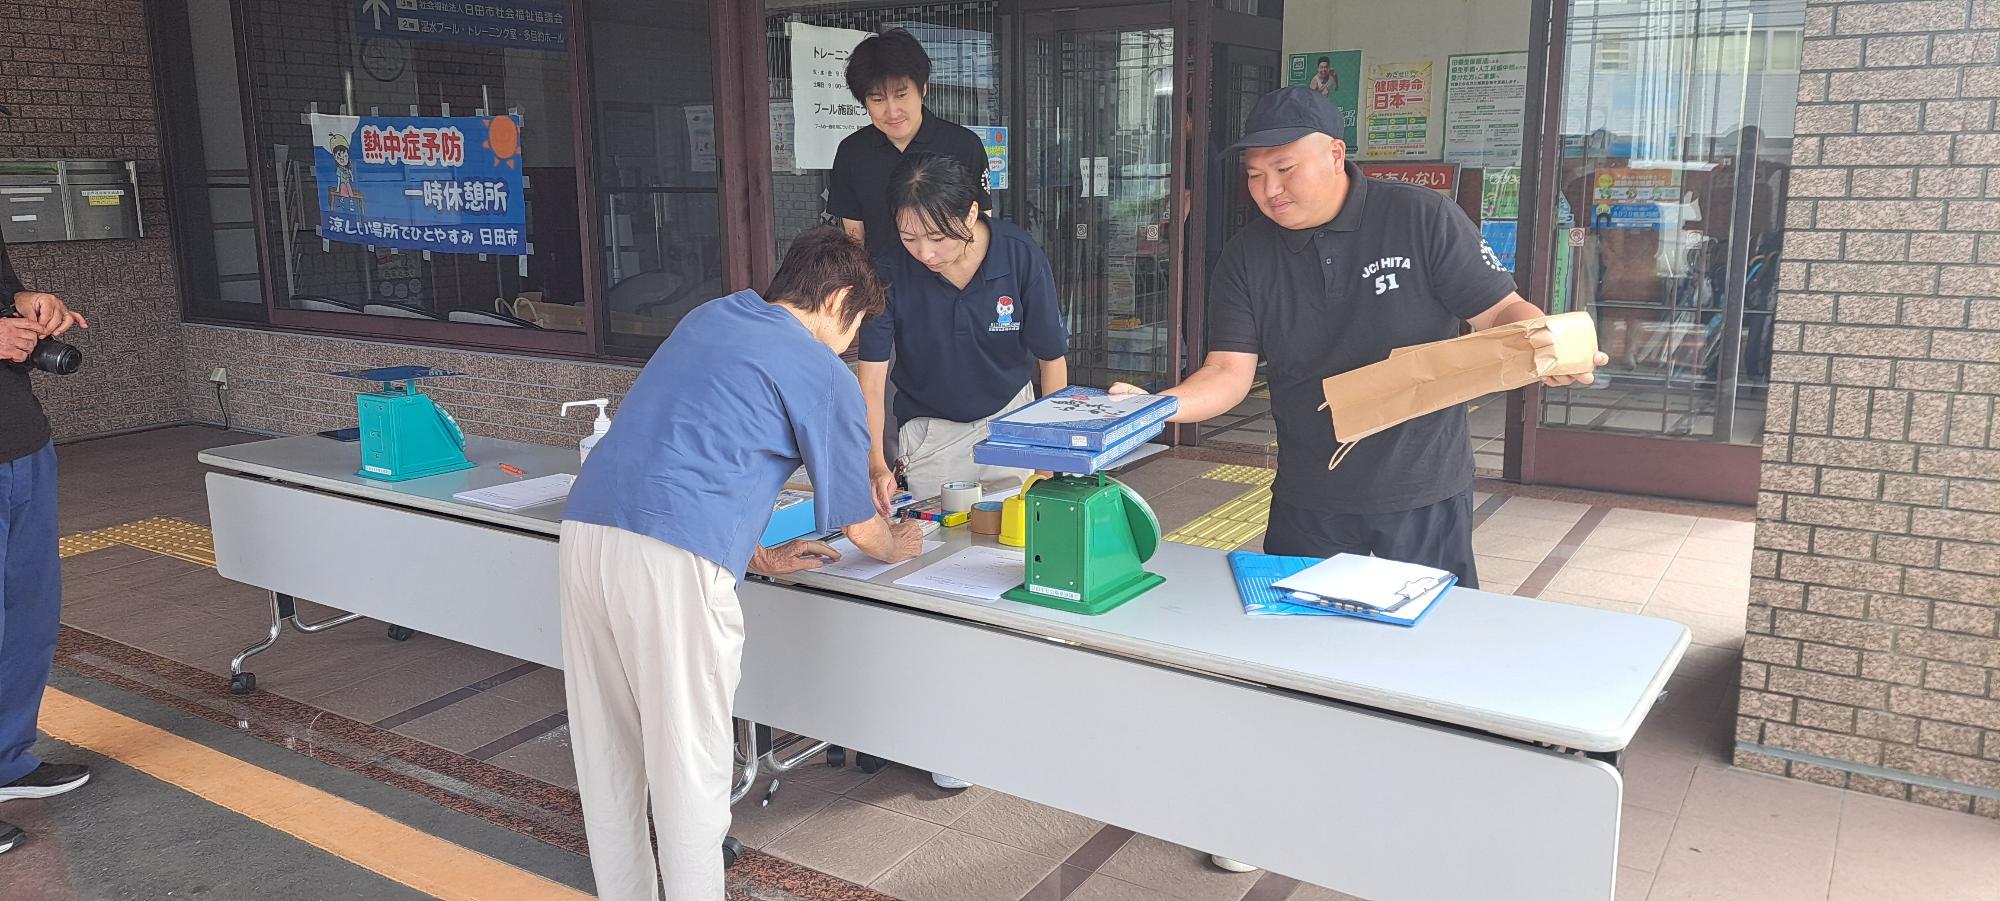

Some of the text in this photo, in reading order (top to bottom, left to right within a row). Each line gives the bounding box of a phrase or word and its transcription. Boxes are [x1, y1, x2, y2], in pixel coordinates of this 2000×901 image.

[1374, 80, 1424, 93] 健康寿命
[1373, 92, 1424, 110] 日本一
[362, 127, 463, 164] 熱中症予防
[404, 179, 508, 213] 一時休憩所
[328, 215, 520, 247] 涼しい場所でひとやすみ 日田市
[1361, 256, 1411, 279] JCI HITA
[1375, 272, 1400, 296] 51
